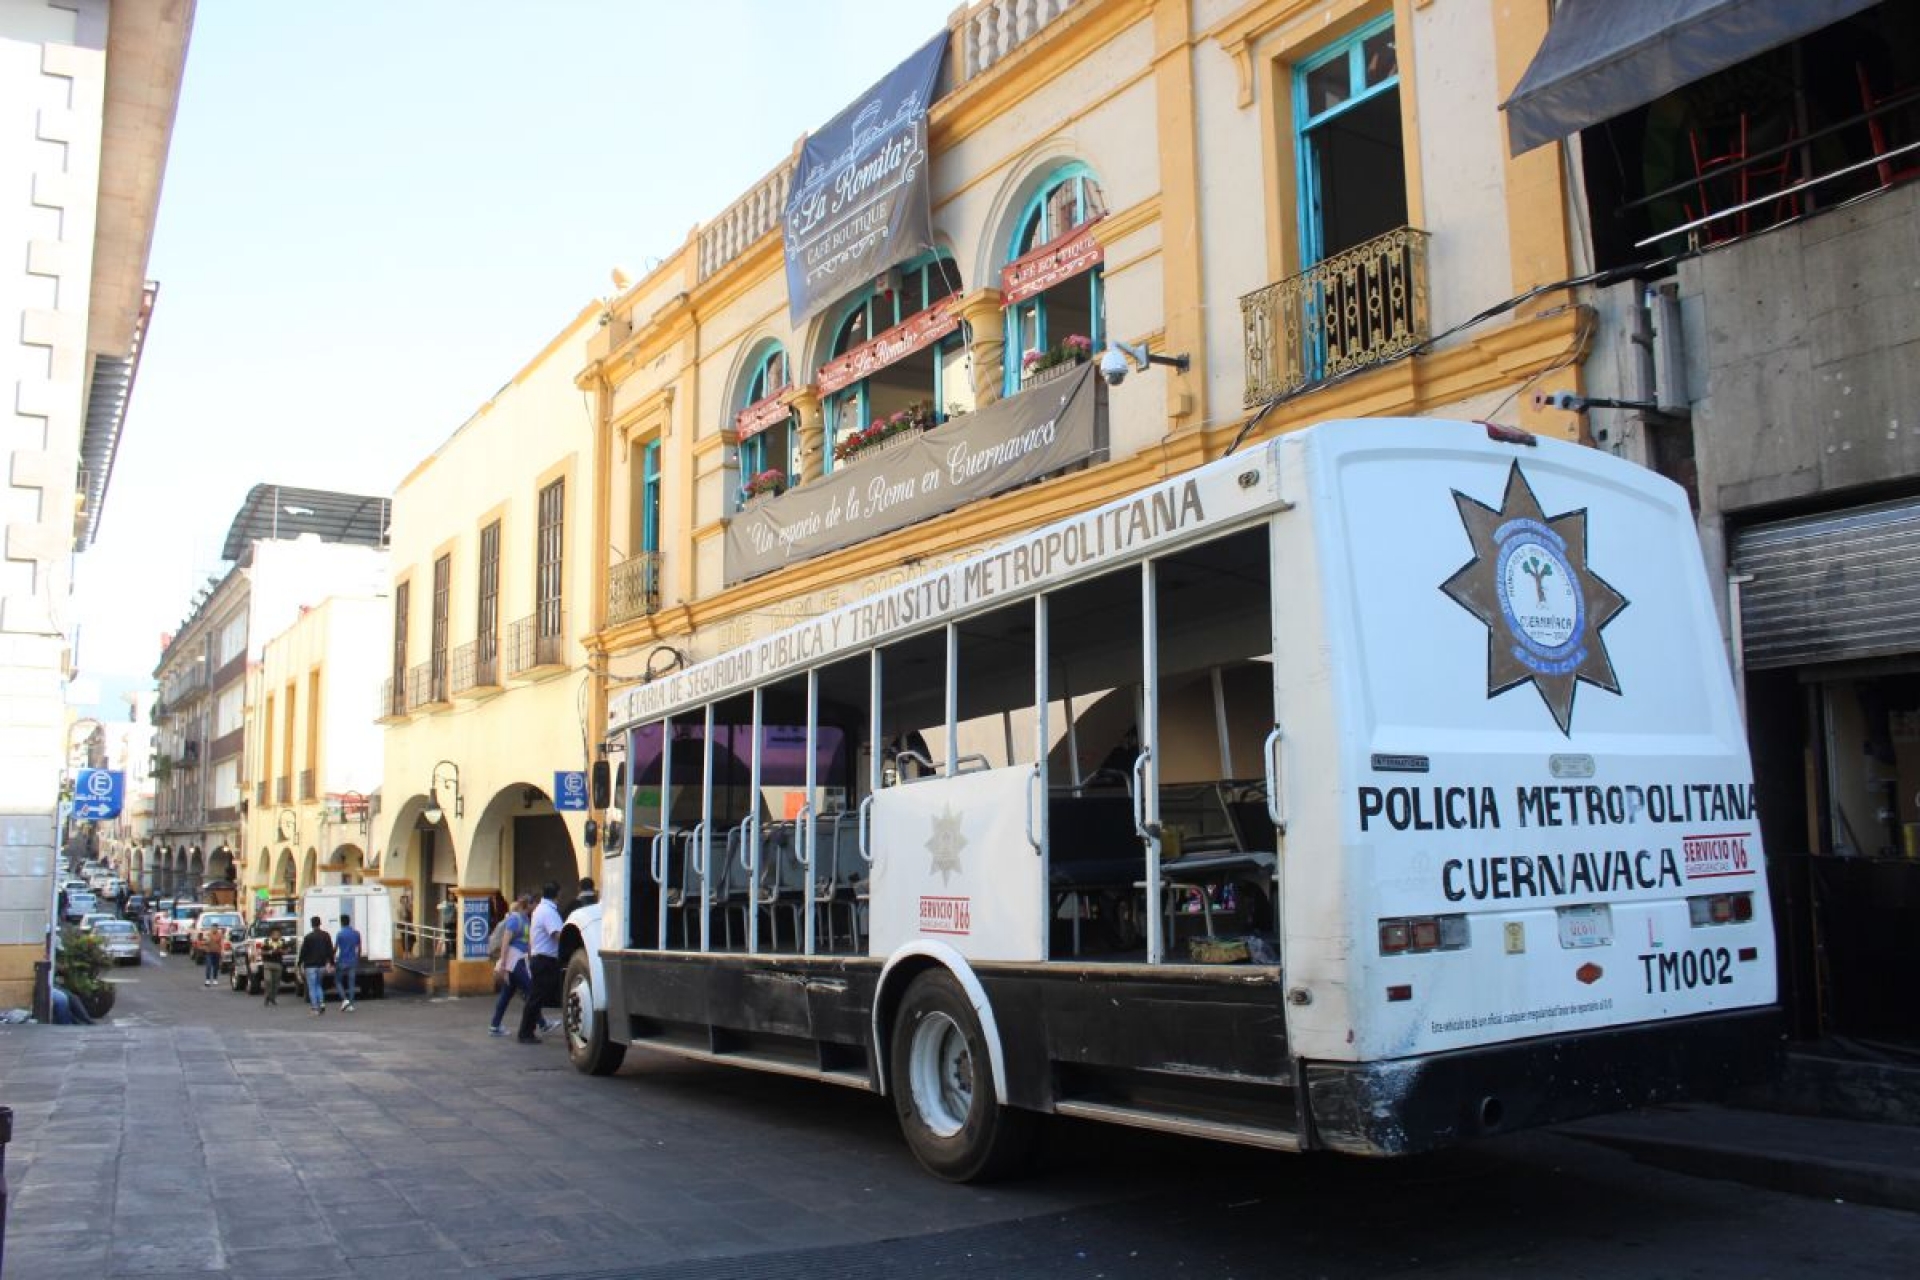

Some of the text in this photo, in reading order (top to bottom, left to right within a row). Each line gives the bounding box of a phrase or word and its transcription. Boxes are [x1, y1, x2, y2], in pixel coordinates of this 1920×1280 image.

[800, 137, 902, 235] La Romita
[833, 202, 887, 249] BOUTIQUE
[779, 511, 821, 555] espacio
[825, 503, 840, 529] de
[846, 486, 859, 520] la
[864, 475, 915, 519] Roma
[921, 472, 939, 493] en
[947, 419, 1056, 486] Cuernavaca
[670, 681, 682, 703] DE
[687, 656, 751, 699] SEGURIDAD
[759, 627, 824, 673] PUBLICA
[831, 614, 842, 645] Y
[850, 575, 950, 643] TRANSITO
[963, 478, 1205, 603] METROPOLITANA
[1358, 787, 1500, 832] POLICIA
[1517, 783, 1760, 828] METROPOLITANA
[1443, 848, 1682, 902] CUERNAVACA
[1683, 841, 1728, 862] SERVICIO
[920, 901, 952, 919] SERVICIO
[1637, 947, 1734, 994] TM002
